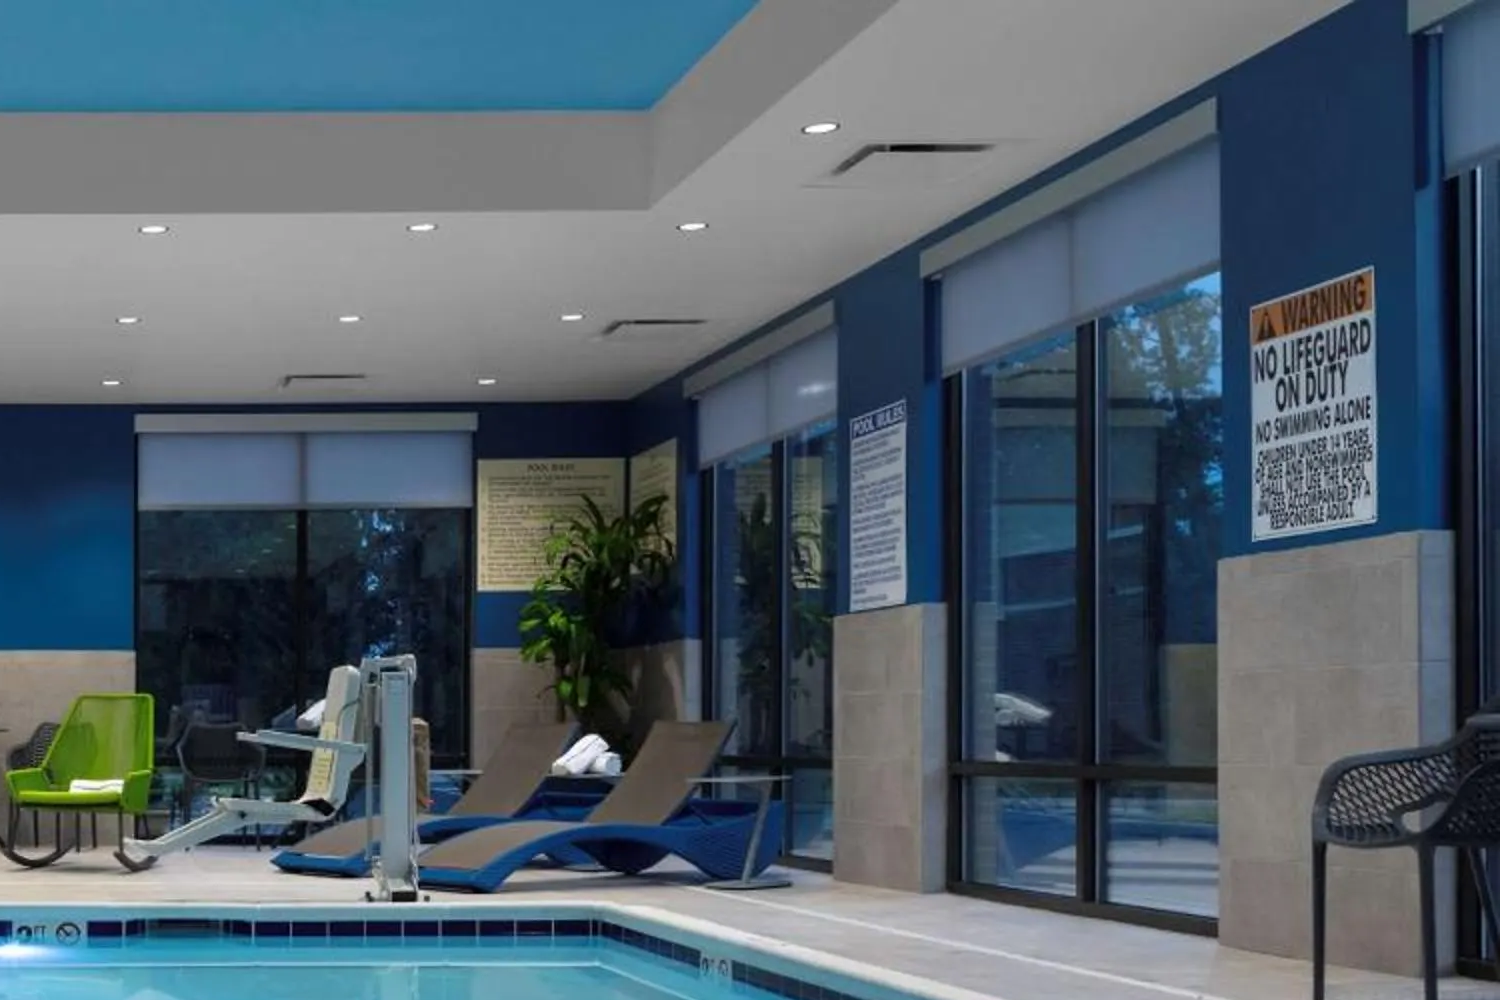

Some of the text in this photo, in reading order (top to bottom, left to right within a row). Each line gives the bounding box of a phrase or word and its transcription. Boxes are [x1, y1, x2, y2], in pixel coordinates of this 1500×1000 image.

[1280, 276, 1367, 335] WARNING
[1254, 318, 1371, 384] NO LIFEGUARD
[1275, 360, 1349, 412] ON DUTY
[853, 415, 875, 438] POOL
[1256, 395, 1371, 444] NO SWIMMING ALONE
[1297, 436, 1327, 459] UNDER
[1342, 427, 1369, 449] YEARS
